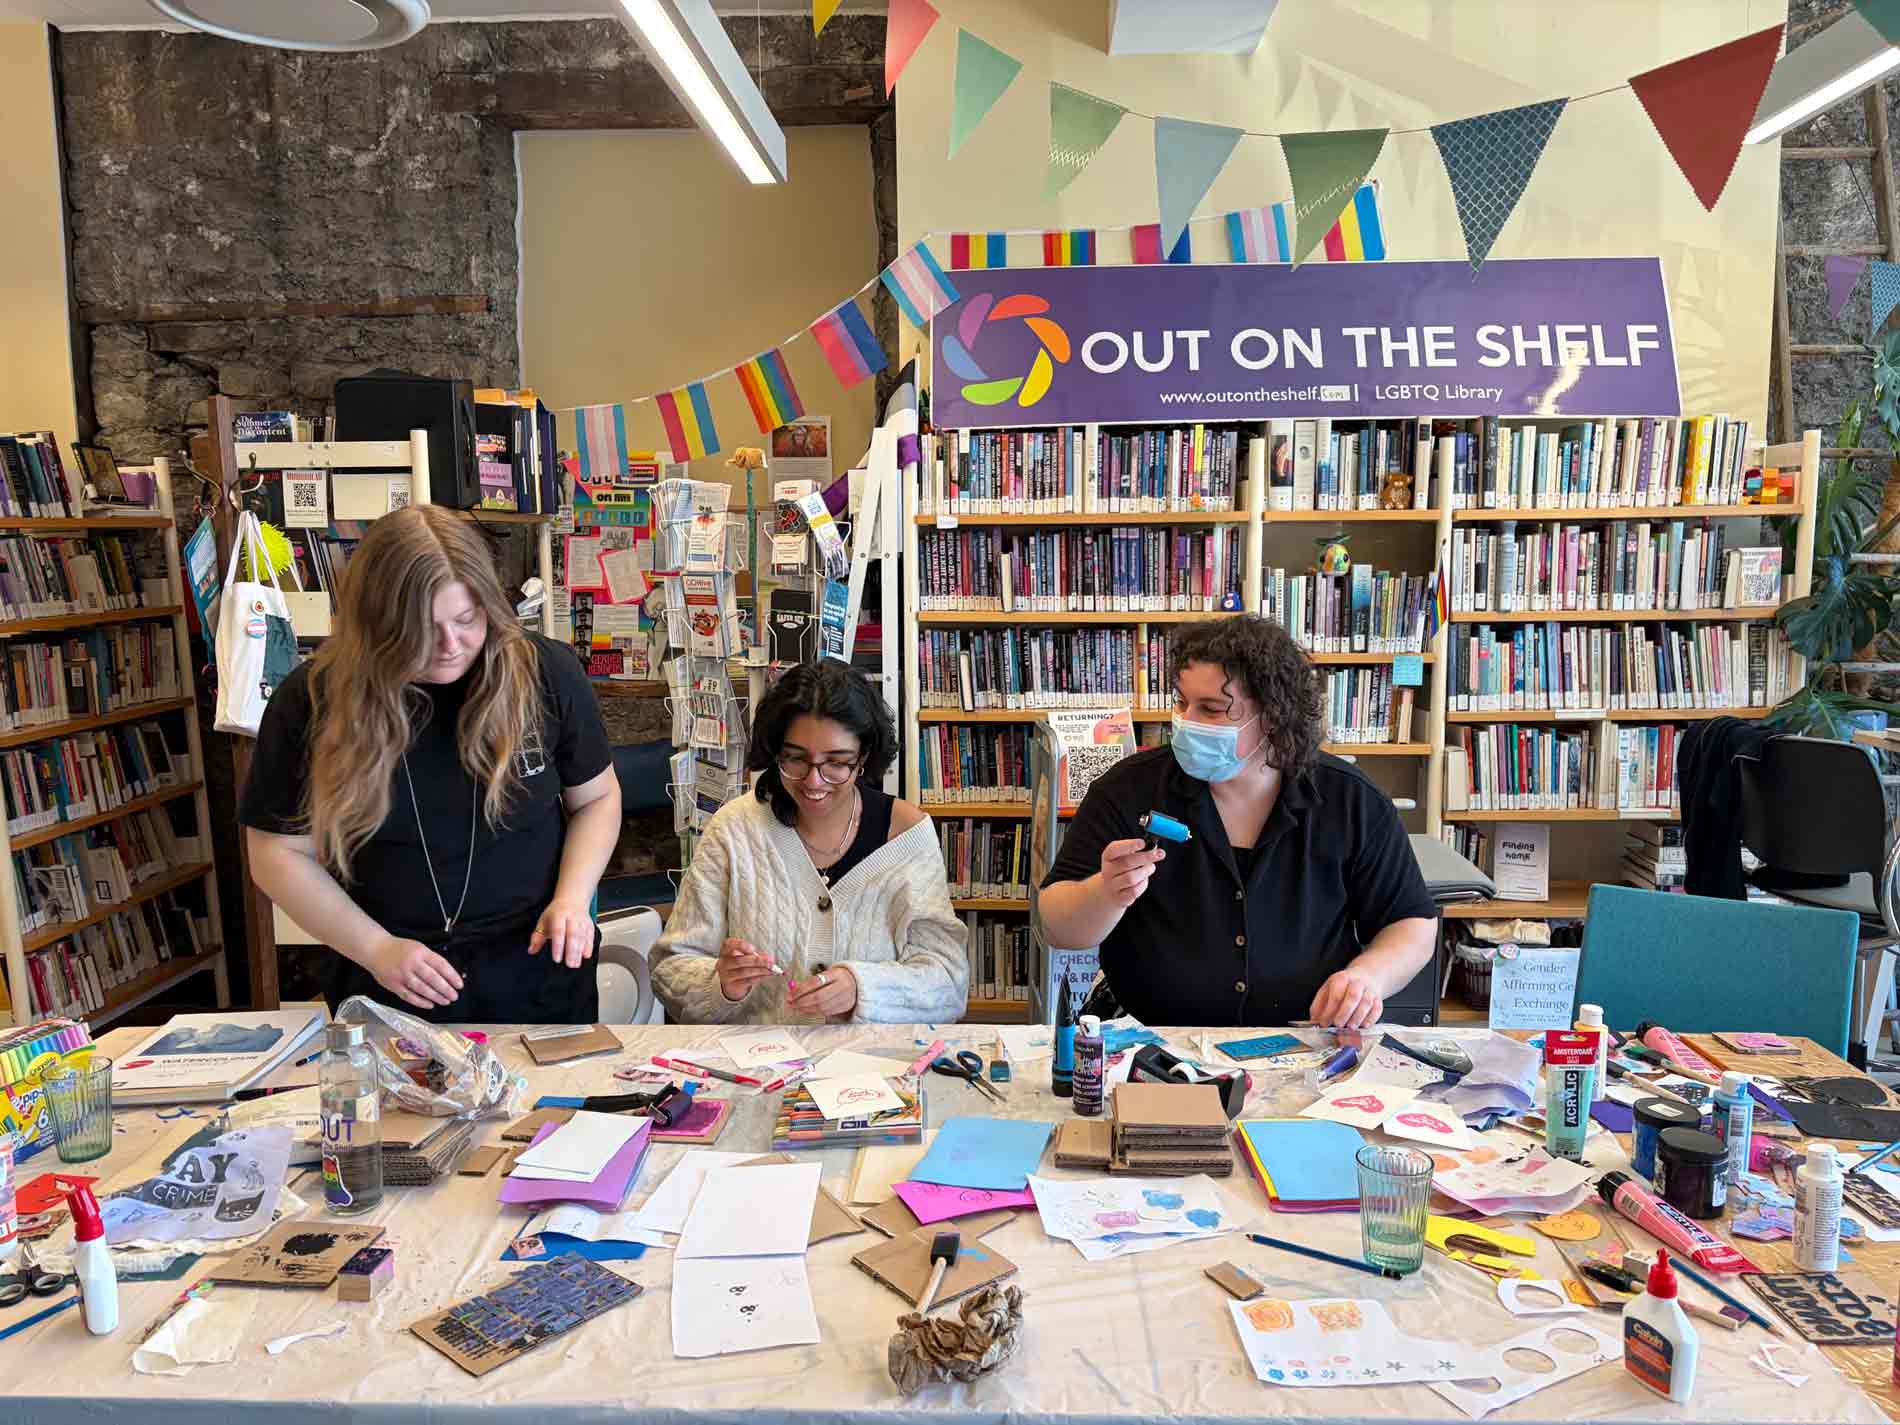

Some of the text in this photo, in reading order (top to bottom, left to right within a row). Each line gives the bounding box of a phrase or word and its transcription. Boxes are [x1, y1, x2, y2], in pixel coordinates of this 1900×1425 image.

[1081, 324, 1660, 374] OUT ON THE SHELF
[1375, 384, 1440, 401] LGBTQ
[1445, 384, 1503, 402] Library
[236, 420, 272, 428] Summer
[1058, 713, 1114, 721] RETURNING?
[1502, 841, 1535, 852] Finding
[1524, 962, 1566, 974] Gender
[1069, 973, 1078, 983] &
[1504, 979, 1556, 992] Affirming
[1512, 997, 1569, 1013] Exchange
[1553, 1047, 1593, 1056] AMSTERDAM
[1566, 1072, 1578, 1125] ACRYLIC
[320, 1113, 358, 1142] OUT
[175, 1152, 239, 1183] AY
[152, 1184, 217, 1203] CRIME
